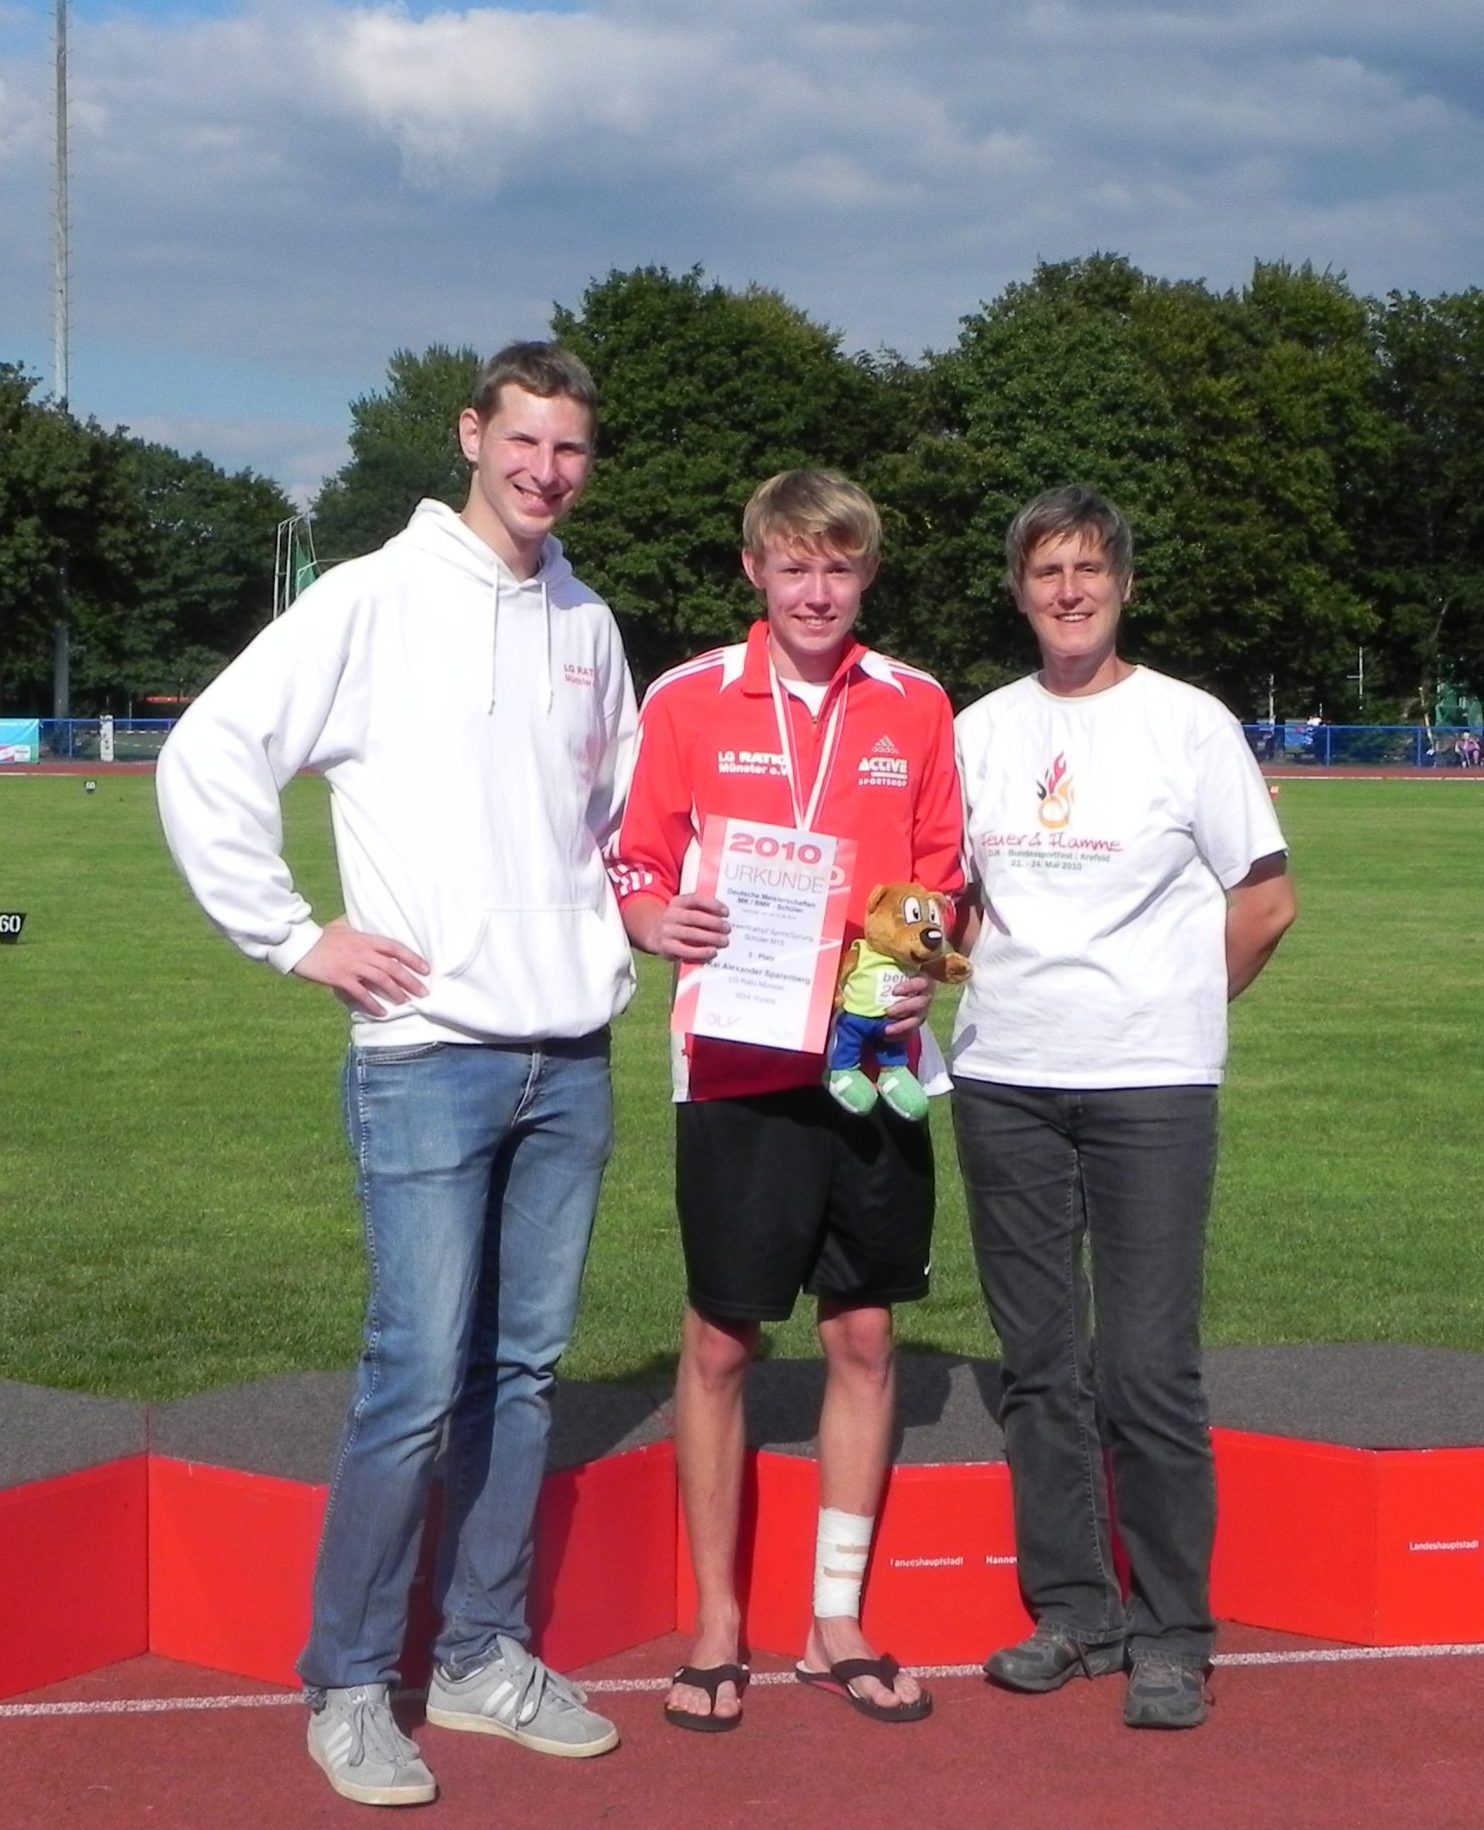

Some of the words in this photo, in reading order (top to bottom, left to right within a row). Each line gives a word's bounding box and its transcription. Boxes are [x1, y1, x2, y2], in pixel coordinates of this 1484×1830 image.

[718, 751, 735, 763] LG
[719, 763, 768, 775] Münster
[858, 757, 908, 774] ACTIVE
[858, 778, 908, 788] SPORTSHOP
[729, 833, 822, 865] 2010
[1008, 850, 1073, 860] Bundessportfest
[1080, 852, 1110, 862] Krefeld
[1045, 860, 1060, 869] Mai
[1062, 861, 1082, 870] 2010
[725, 863, 827, 894] URKUNDE
[727, 887, 760, 900] Deutsche
[761, 894, 816, 908] Meisterschaften
[0, 914, 21, 933] 60
[758, 952, 775, 962] Platz
[722, 961, 762, 975] Alexander
[1408, 1540, 1480, 1551] Landeshauptstadt
